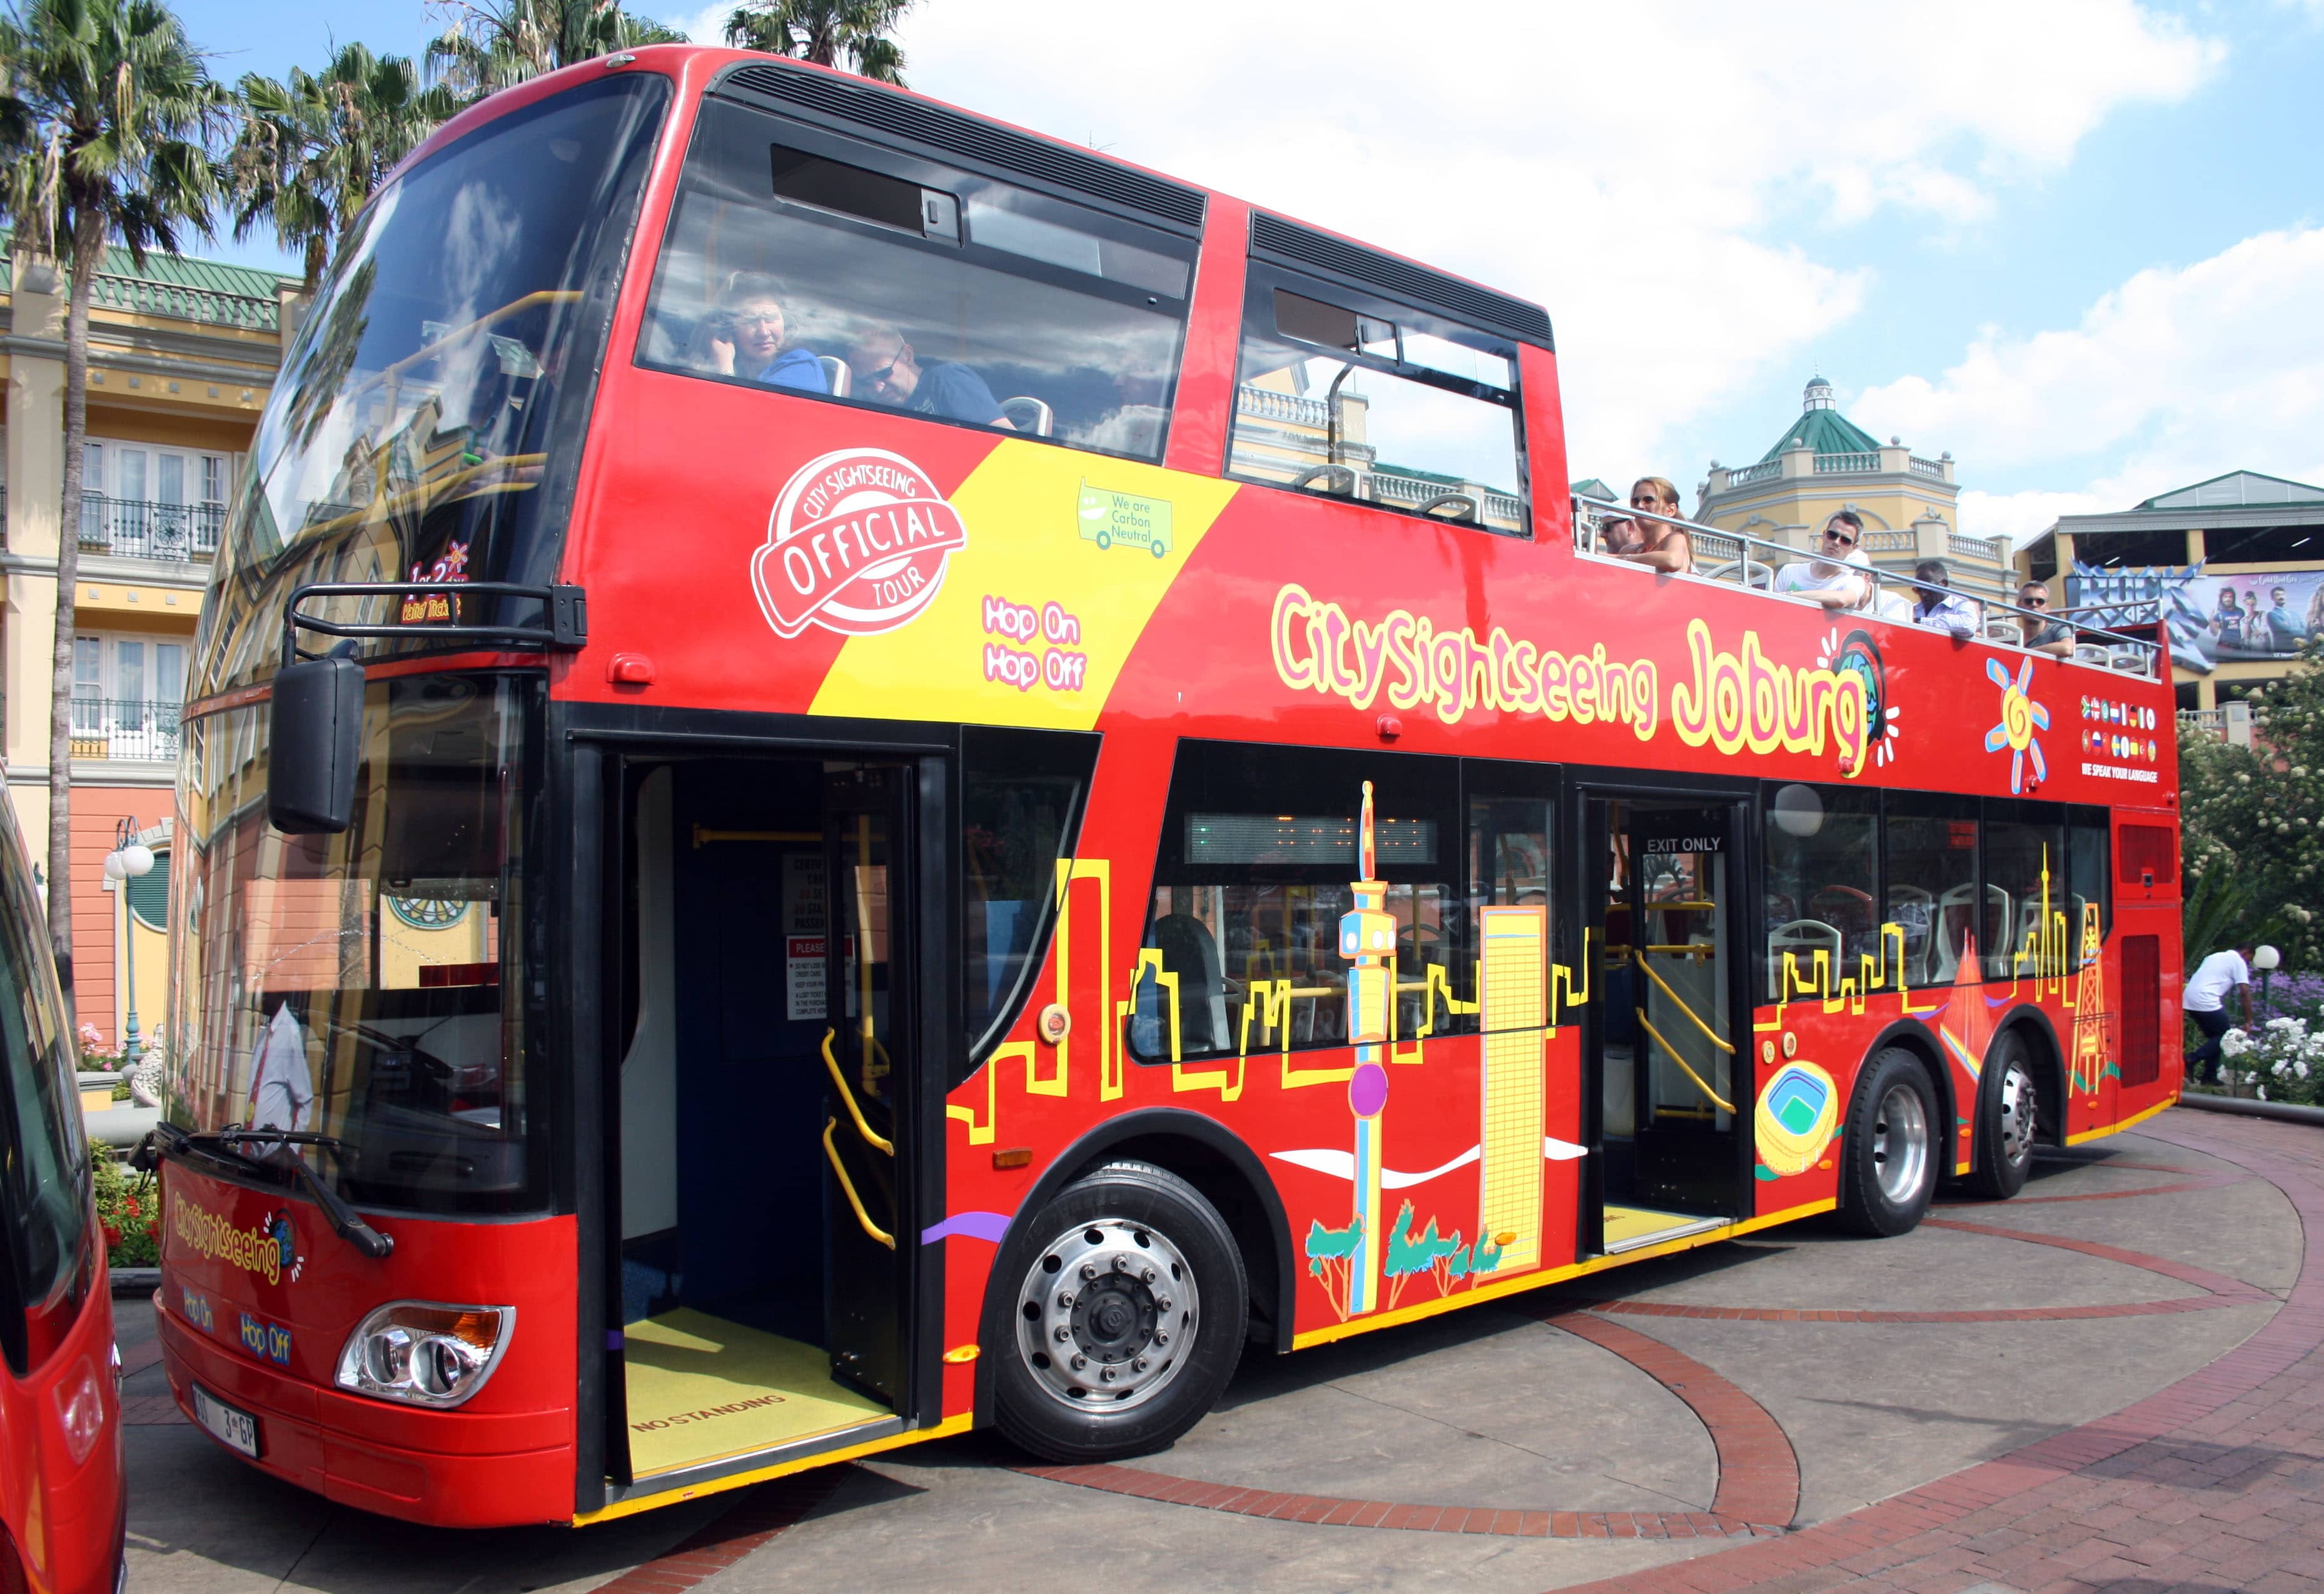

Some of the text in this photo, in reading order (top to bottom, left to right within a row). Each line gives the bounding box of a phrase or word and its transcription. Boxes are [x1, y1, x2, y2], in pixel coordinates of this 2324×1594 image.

[803, 465, 916, 519] CITY SIGHTSEEING
[1111, 495, 1150, 513] We are
[1111, 510, 1150, 528] Carbon
[1111, 524, 1151, 543] Neutral
[783, 506, 945, 595] OFFICIAL
[872, 566, 926, 606] TOUR
[428, 598, 462, 617] Tickt
[983, 596, 1079, 644] Hop On
[984, 644, 1086, 689] Hop Off
[1271, 583, 1869, 779] CitySightseeing Joburg
[2081, 763, 2158, 783] WE SPEAK YOUR LANGUAGE
[1647, 837, 1721, 852] EXIT ONLY
[796, 943, 826, 953] PLEASE
[183, 1287, 200, 1324] Hop
[241, 1314, 290, 1363] Hop Off
[225, 1409, 232, 1438] 3
[239, 1416, 253, 1447] GP
[630, 1395, 786, 1433] NO STANDING
